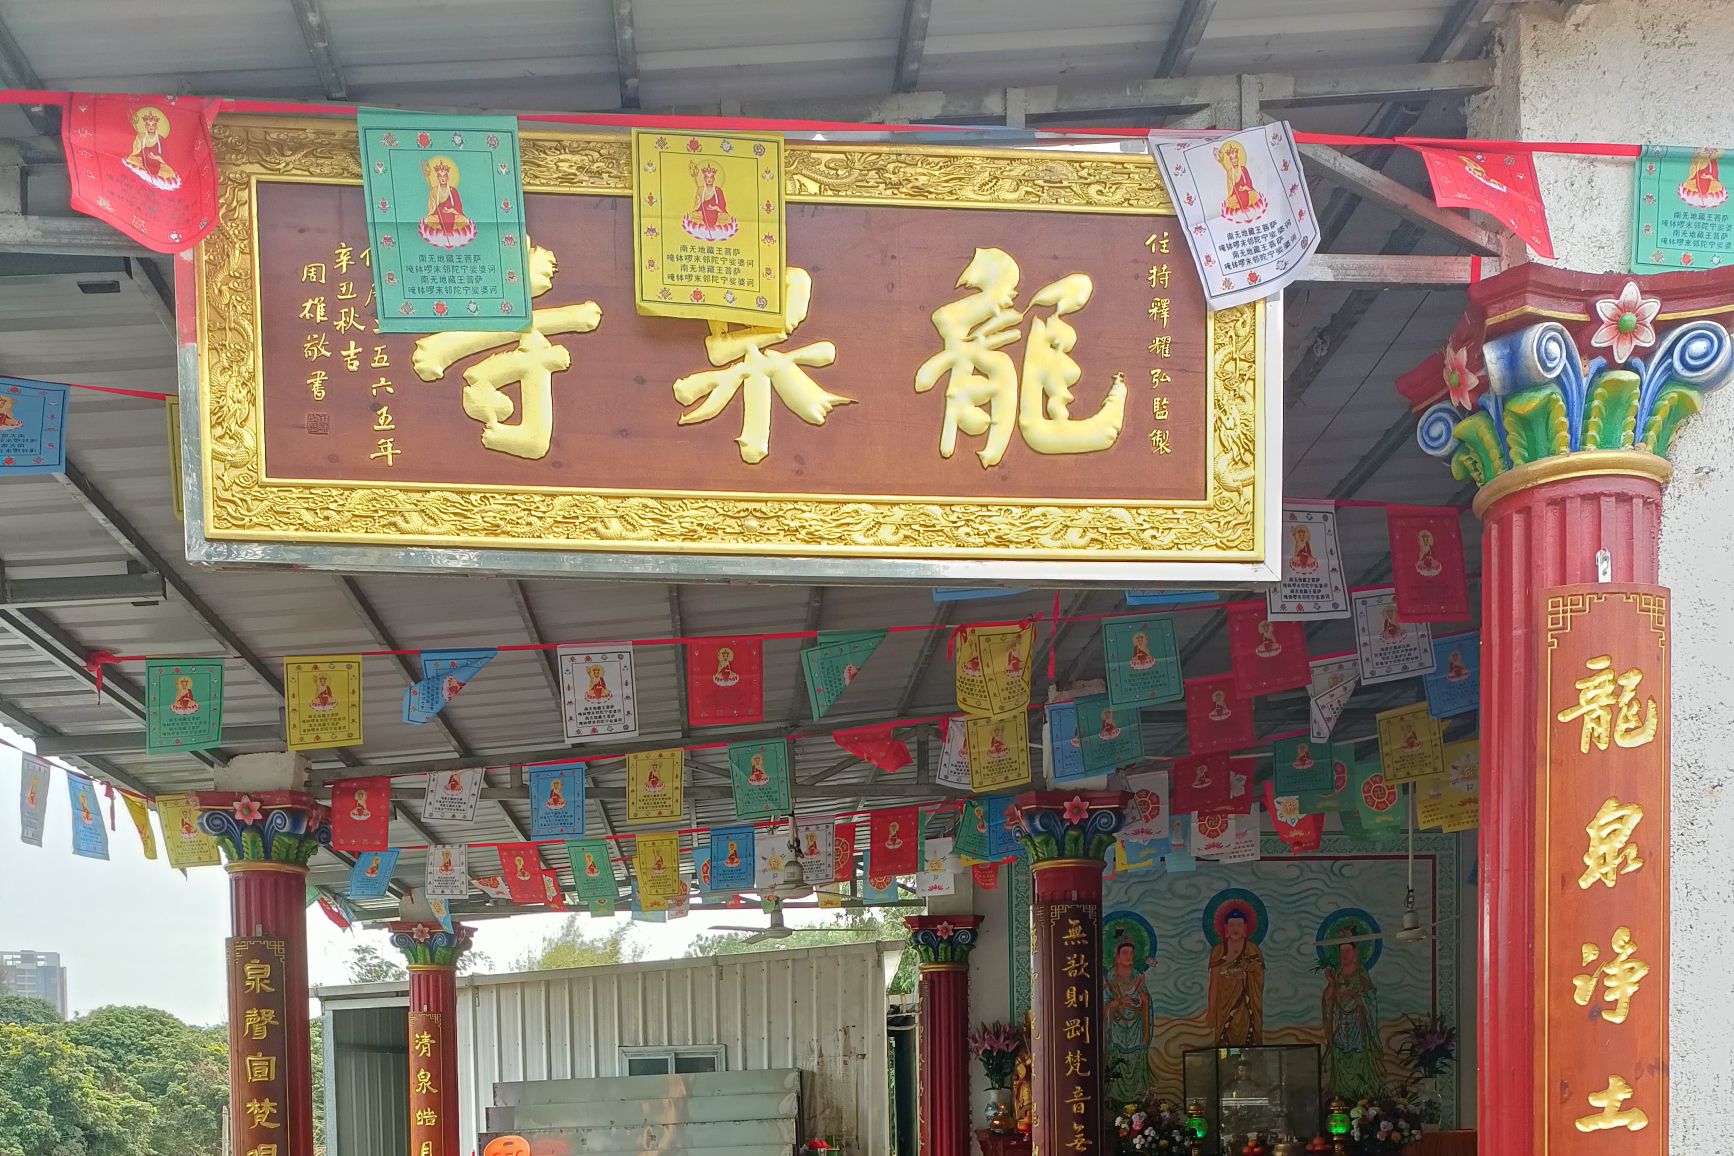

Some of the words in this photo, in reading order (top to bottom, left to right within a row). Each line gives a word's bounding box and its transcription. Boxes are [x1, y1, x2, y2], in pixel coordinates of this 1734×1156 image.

[680, 244, 741, 257] 南无地藏王菩萨
[418, 254, 481, 264] 南无地藏王菩萨
[680, 264, 741, 275] 南无地藏王菩萨
[420, 275, 483, 285] 南无地藏王菩萨
[333, 242, 366, 372] 辛丑秋吉
[299, 263, 332, 401] 周雄敬書
